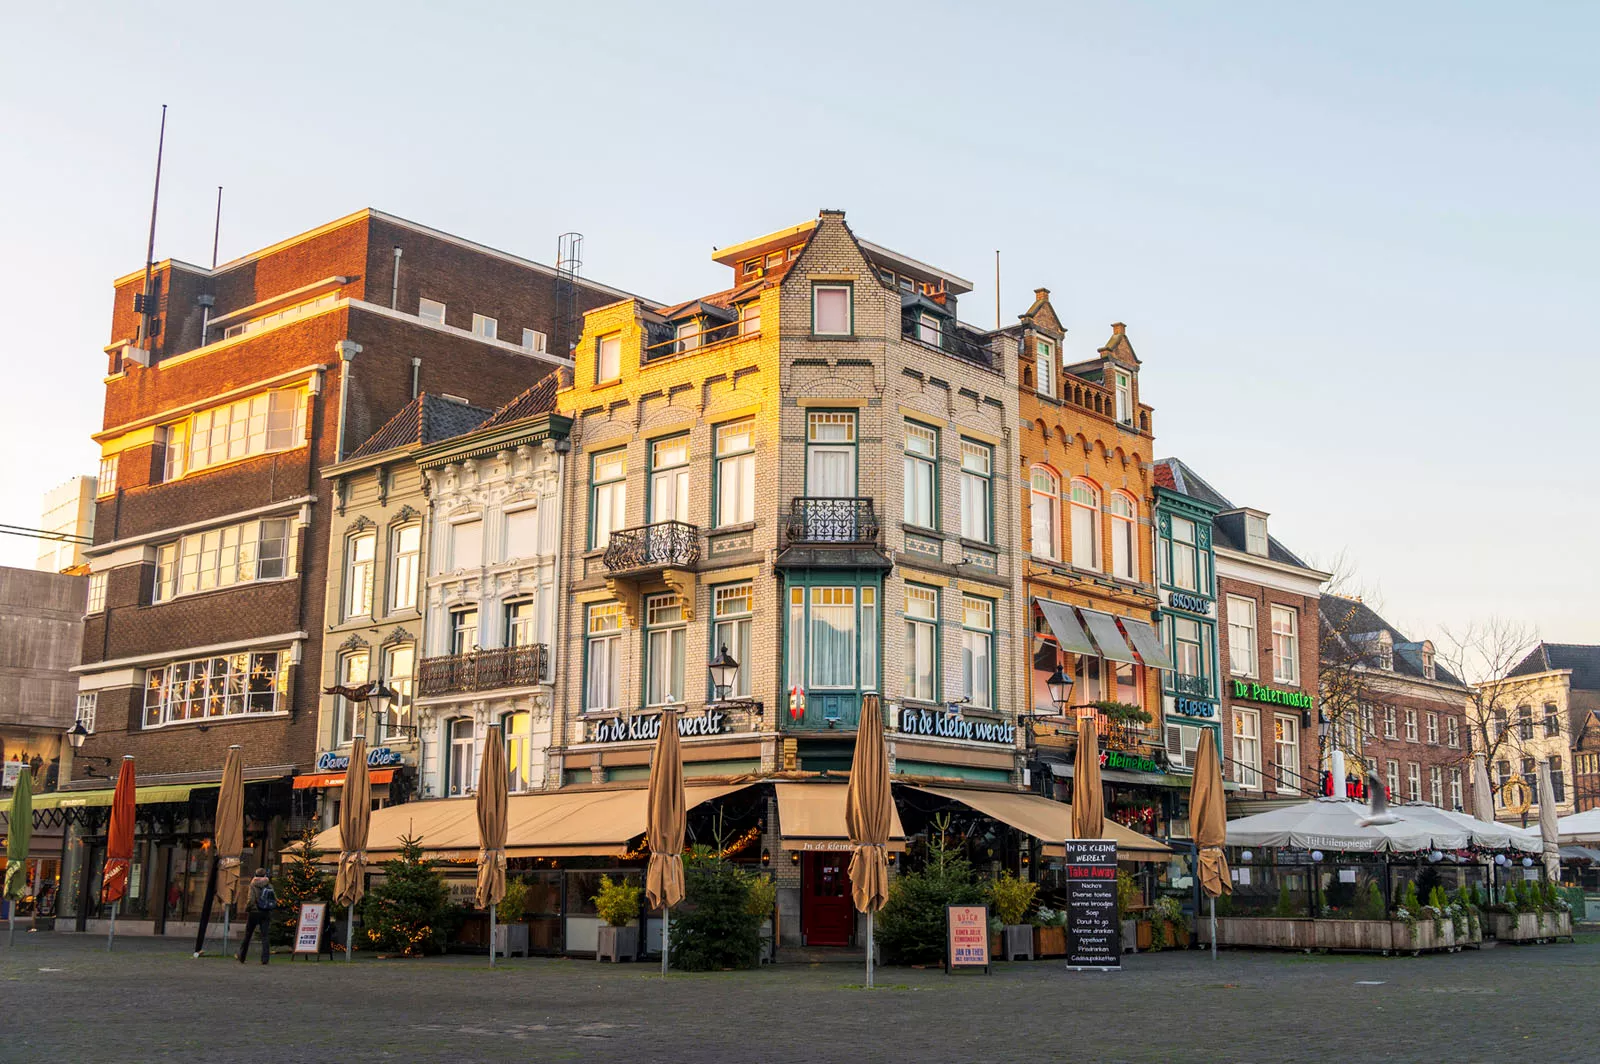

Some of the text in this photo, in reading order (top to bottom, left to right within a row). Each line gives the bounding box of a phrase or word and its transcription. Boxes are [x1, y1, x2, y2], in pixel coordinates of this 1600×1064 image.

[1173, 592, 1210, 614] BROODJE
[1234, 679, 1314, 709] De Paternoster
[595, 719, 609, 742] In
[610, 717, 626, 740] de
[627, 714, 663, 740] klein
[904, 709, 1016, 743] In de kleine werelt
[317, 747, 395, 769] Bava Bier
[1108, 752, 1156, 772] Heineken
[815, 841, 825, 850] de
[1077, 844, 1088, 852] DE
[1089, 844, 1116, 852] KLEINE
[1076, 854, 1107, 862] WERELT
[1068, 865, 1116, 880] Take Away
